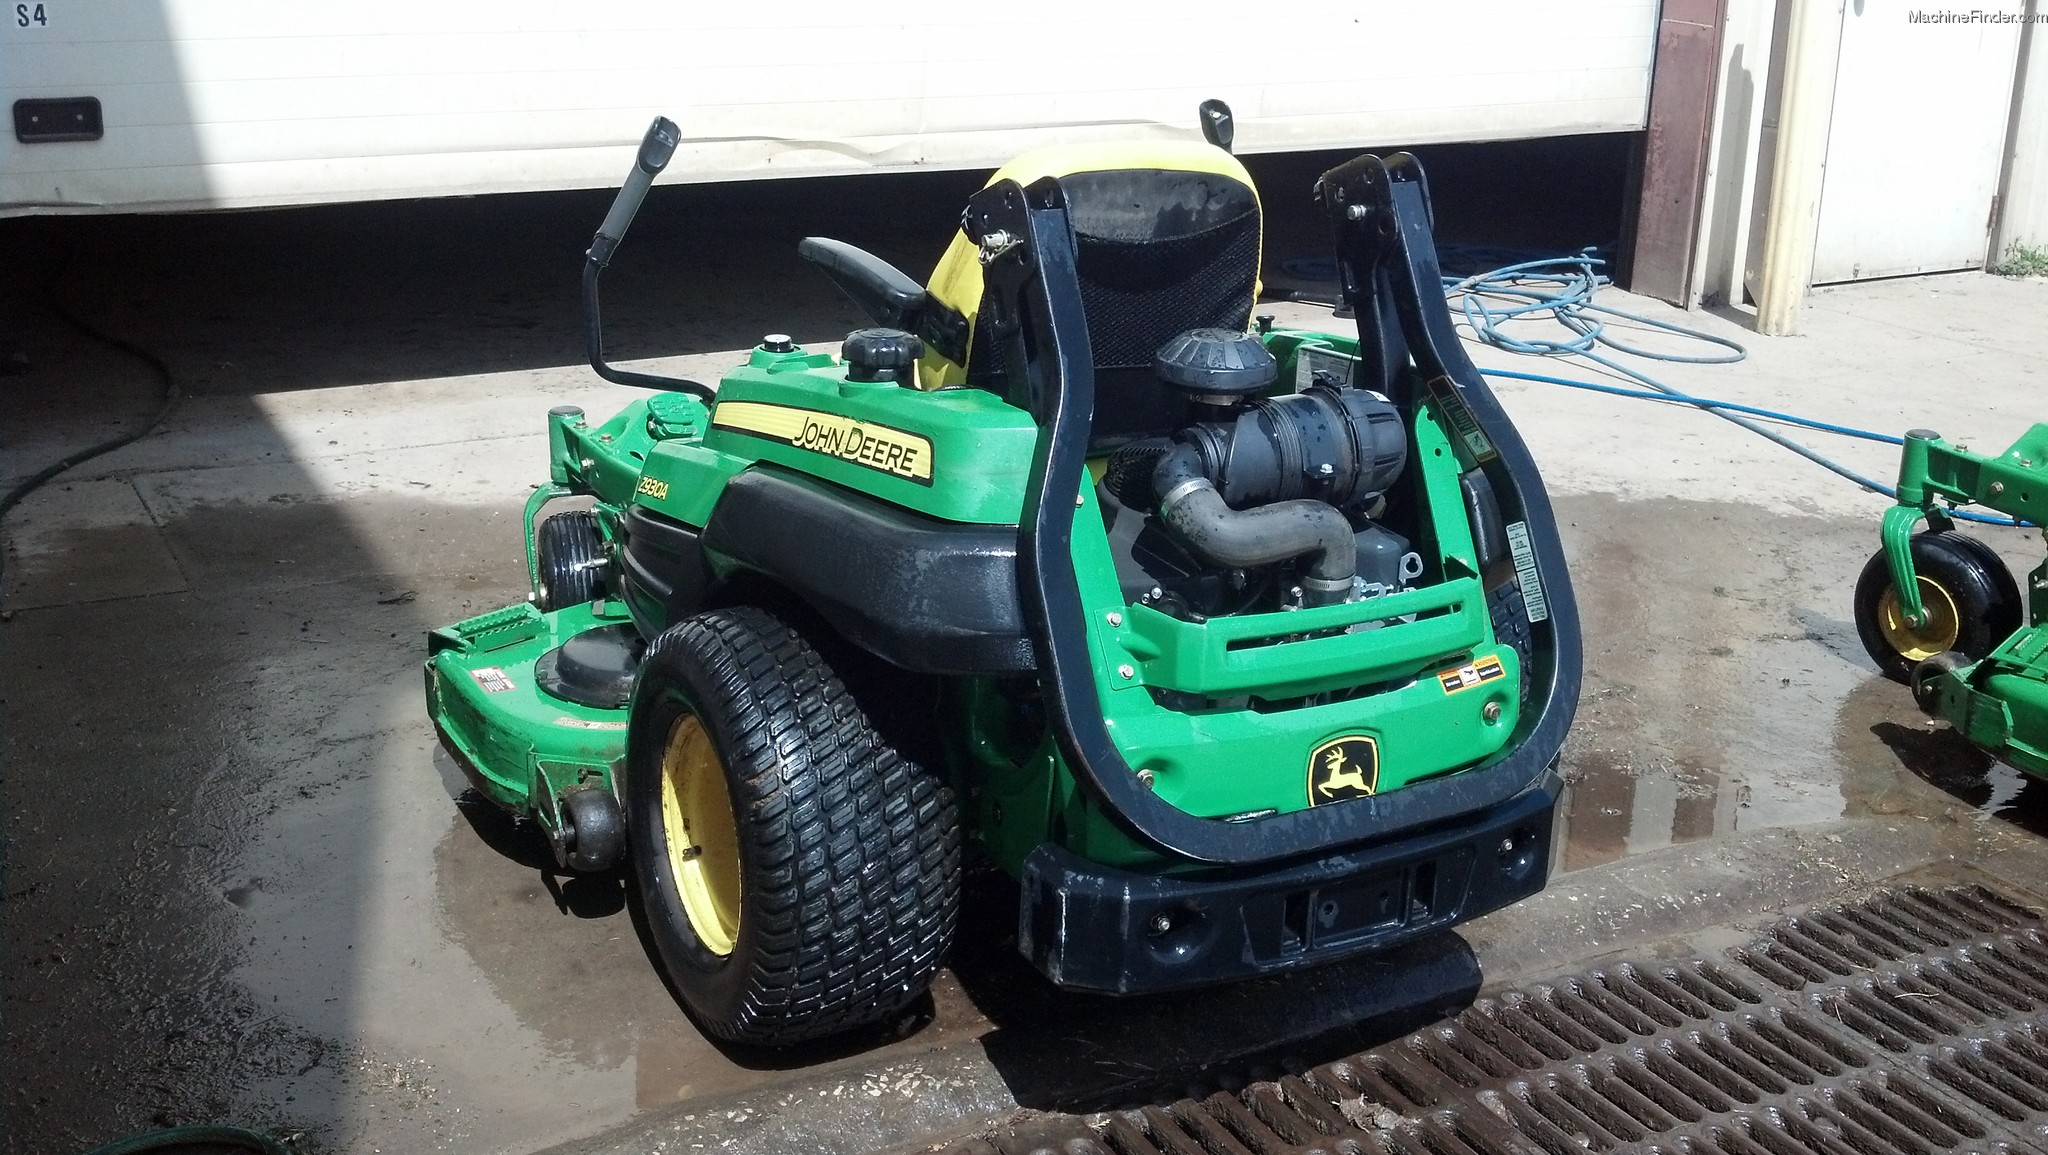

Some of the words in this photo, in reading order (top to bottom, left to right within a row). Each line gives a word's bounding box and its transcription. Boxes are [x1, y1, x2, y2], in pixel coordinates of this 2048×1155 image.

[794, 416, 845, 450] JOHN
[844, 426, 918, 473] DEERE
[637, 475, 670, 501] Z930A
